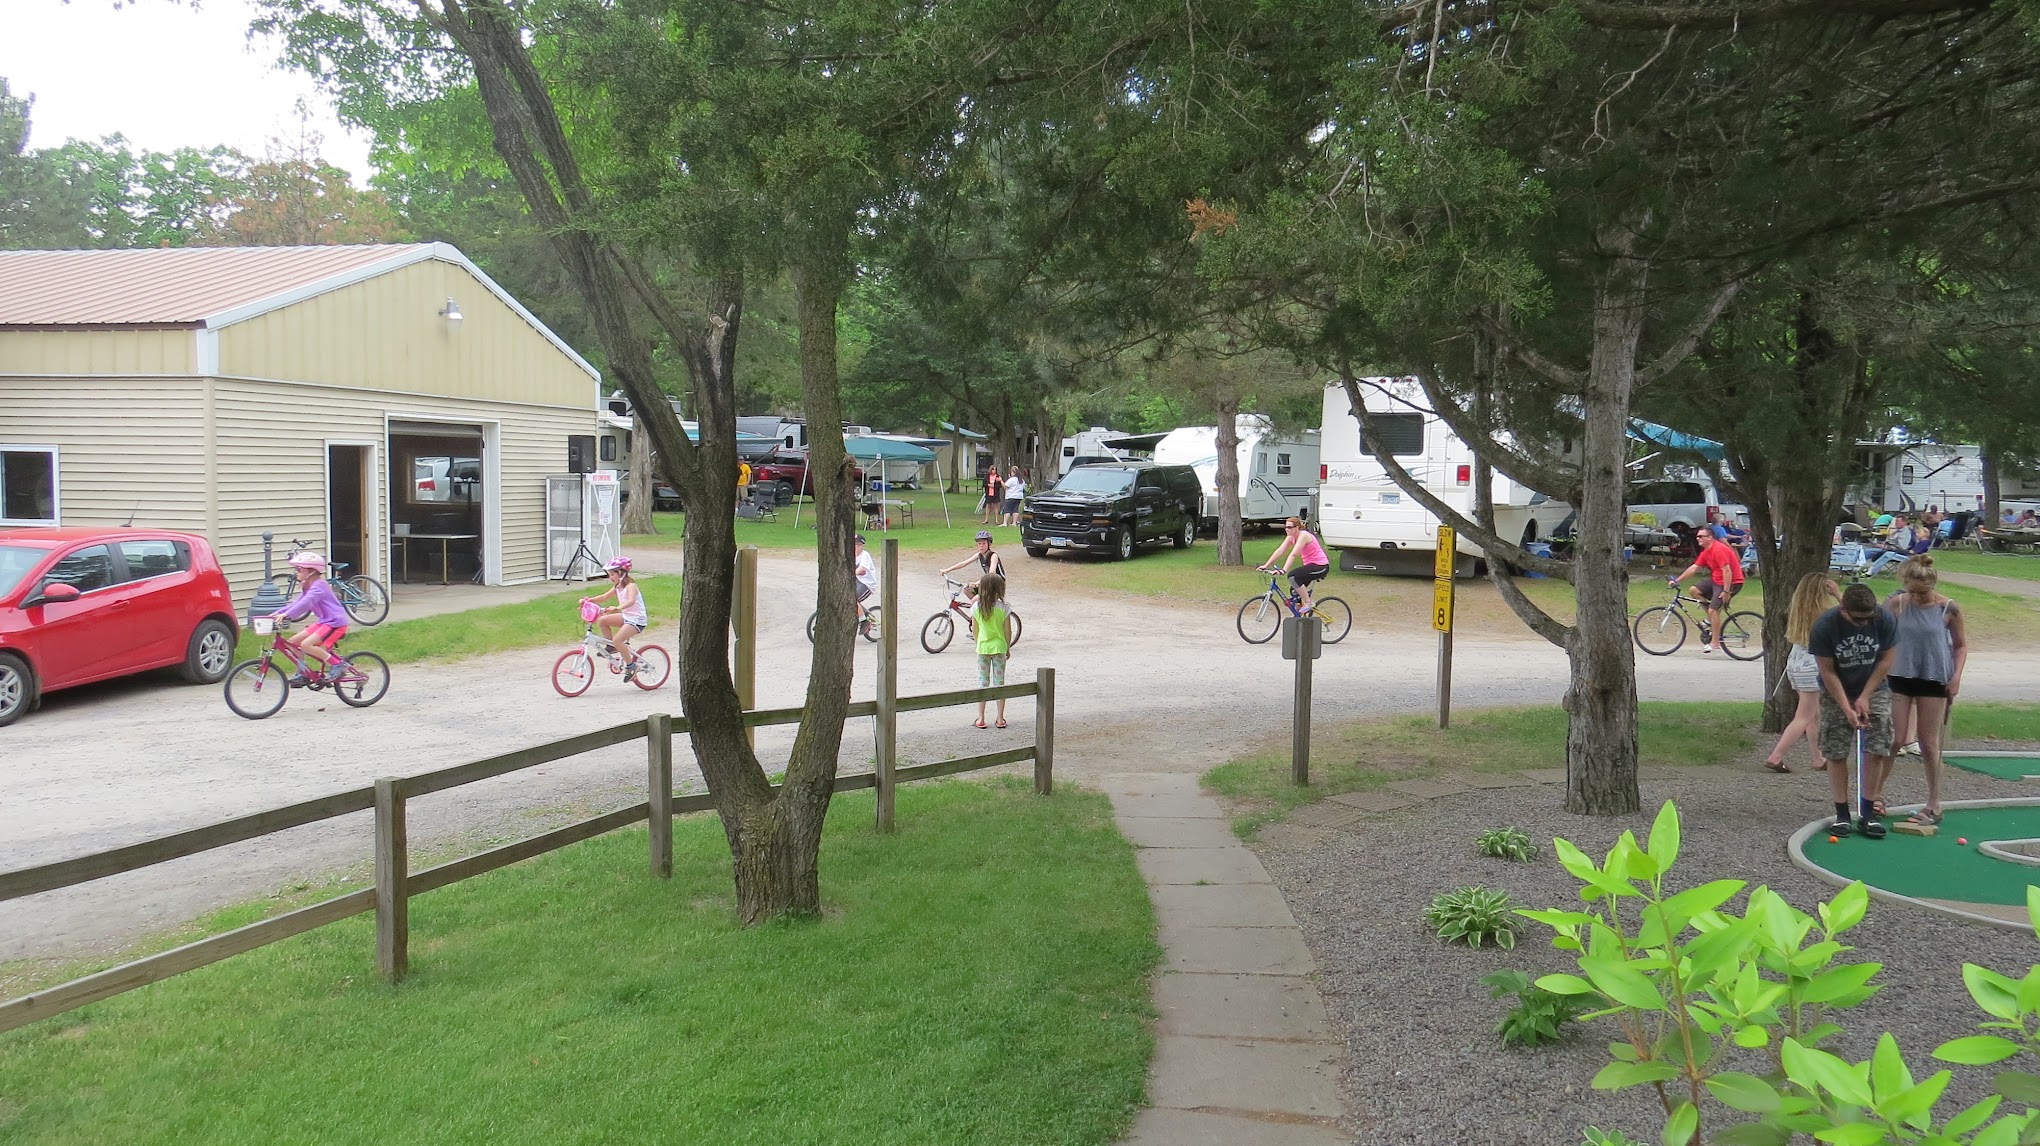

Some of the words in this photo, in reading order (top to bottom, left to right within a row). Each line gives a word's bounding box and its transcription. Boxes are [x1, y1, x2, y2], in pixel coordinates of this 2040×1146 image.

[1329, 465, 1355, 480] Dolphin
[1439, 529, 1451, 537] SLOW
[1436, 584, 1450, 592] SPEED
[1438, 608, 1445, 626] 8
[1835, 634, 1880, 658] ARIZONA
